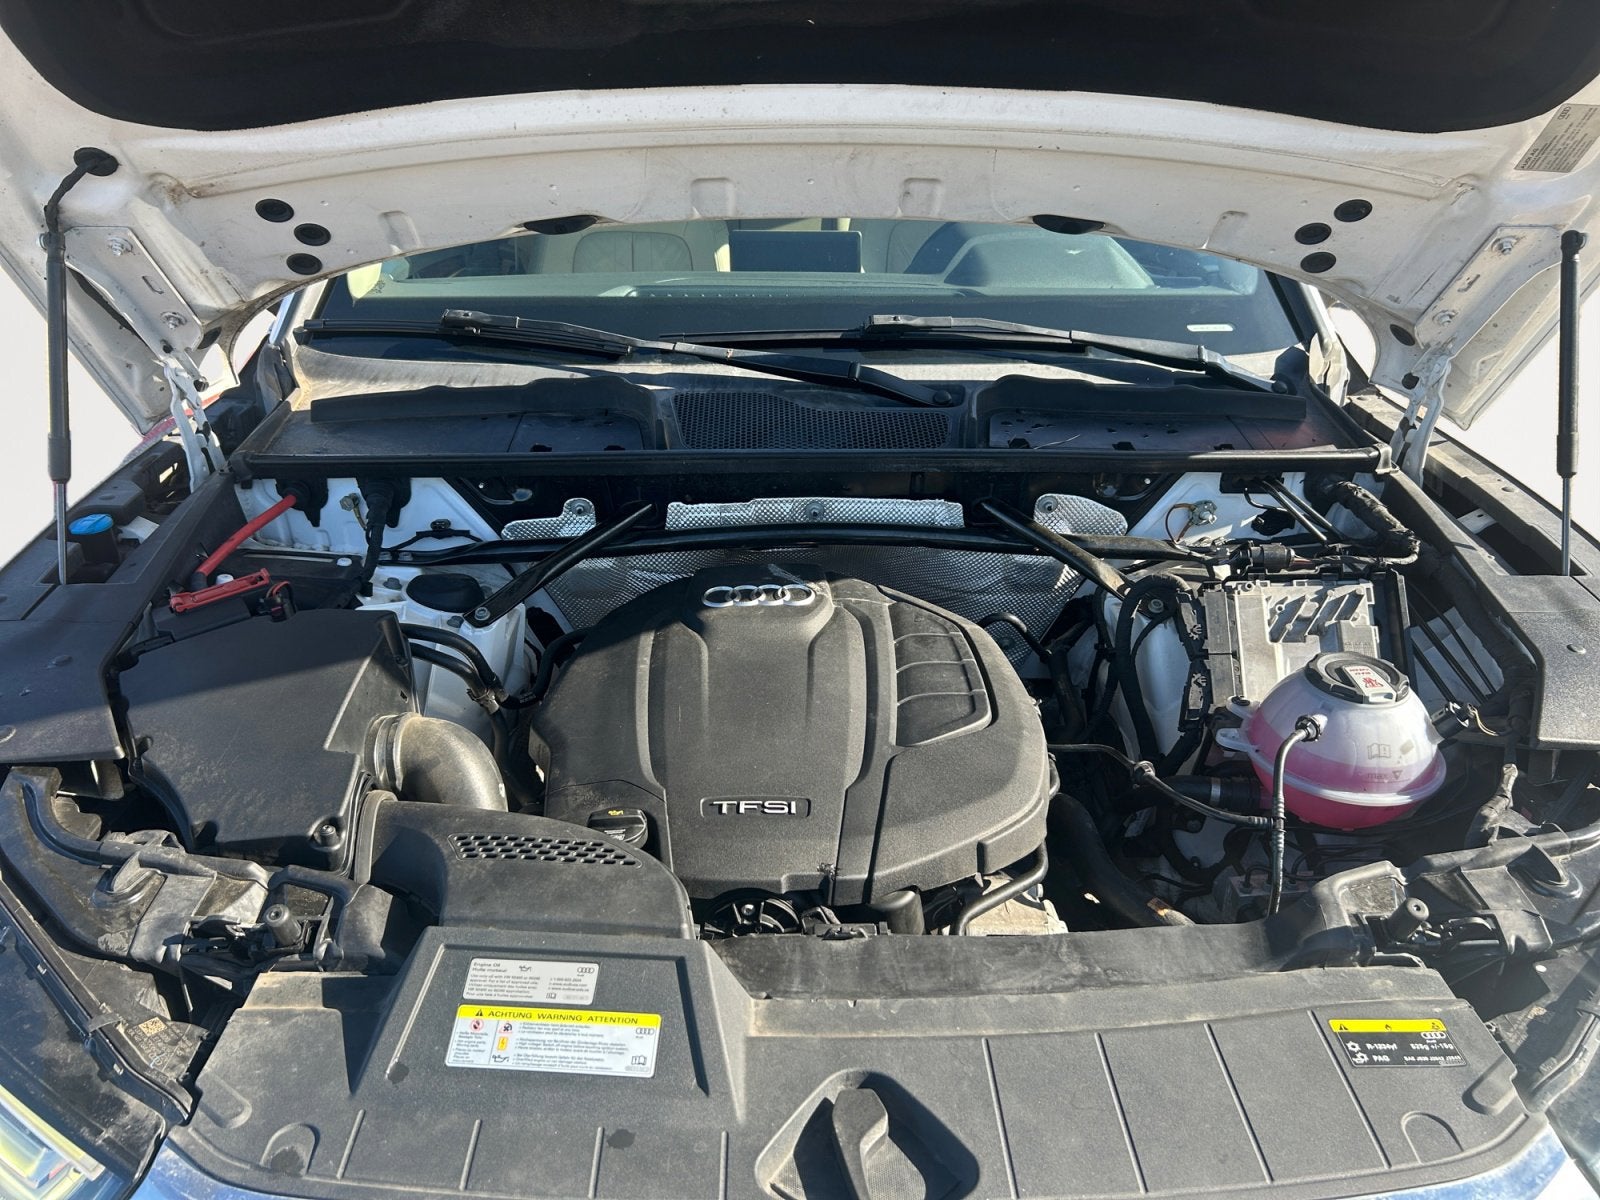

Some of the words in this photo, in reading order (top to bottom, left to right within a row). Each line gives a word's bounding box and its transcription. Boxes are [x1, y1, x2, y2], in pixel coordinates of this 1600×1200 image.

[712, 800, 797, 814] TFSI
[488, 1010, 533, 1019] ACHTUNG
[537, 1013, 583, 1022] WARNING
[587, 1016, 639, 1024] ATTENTION
